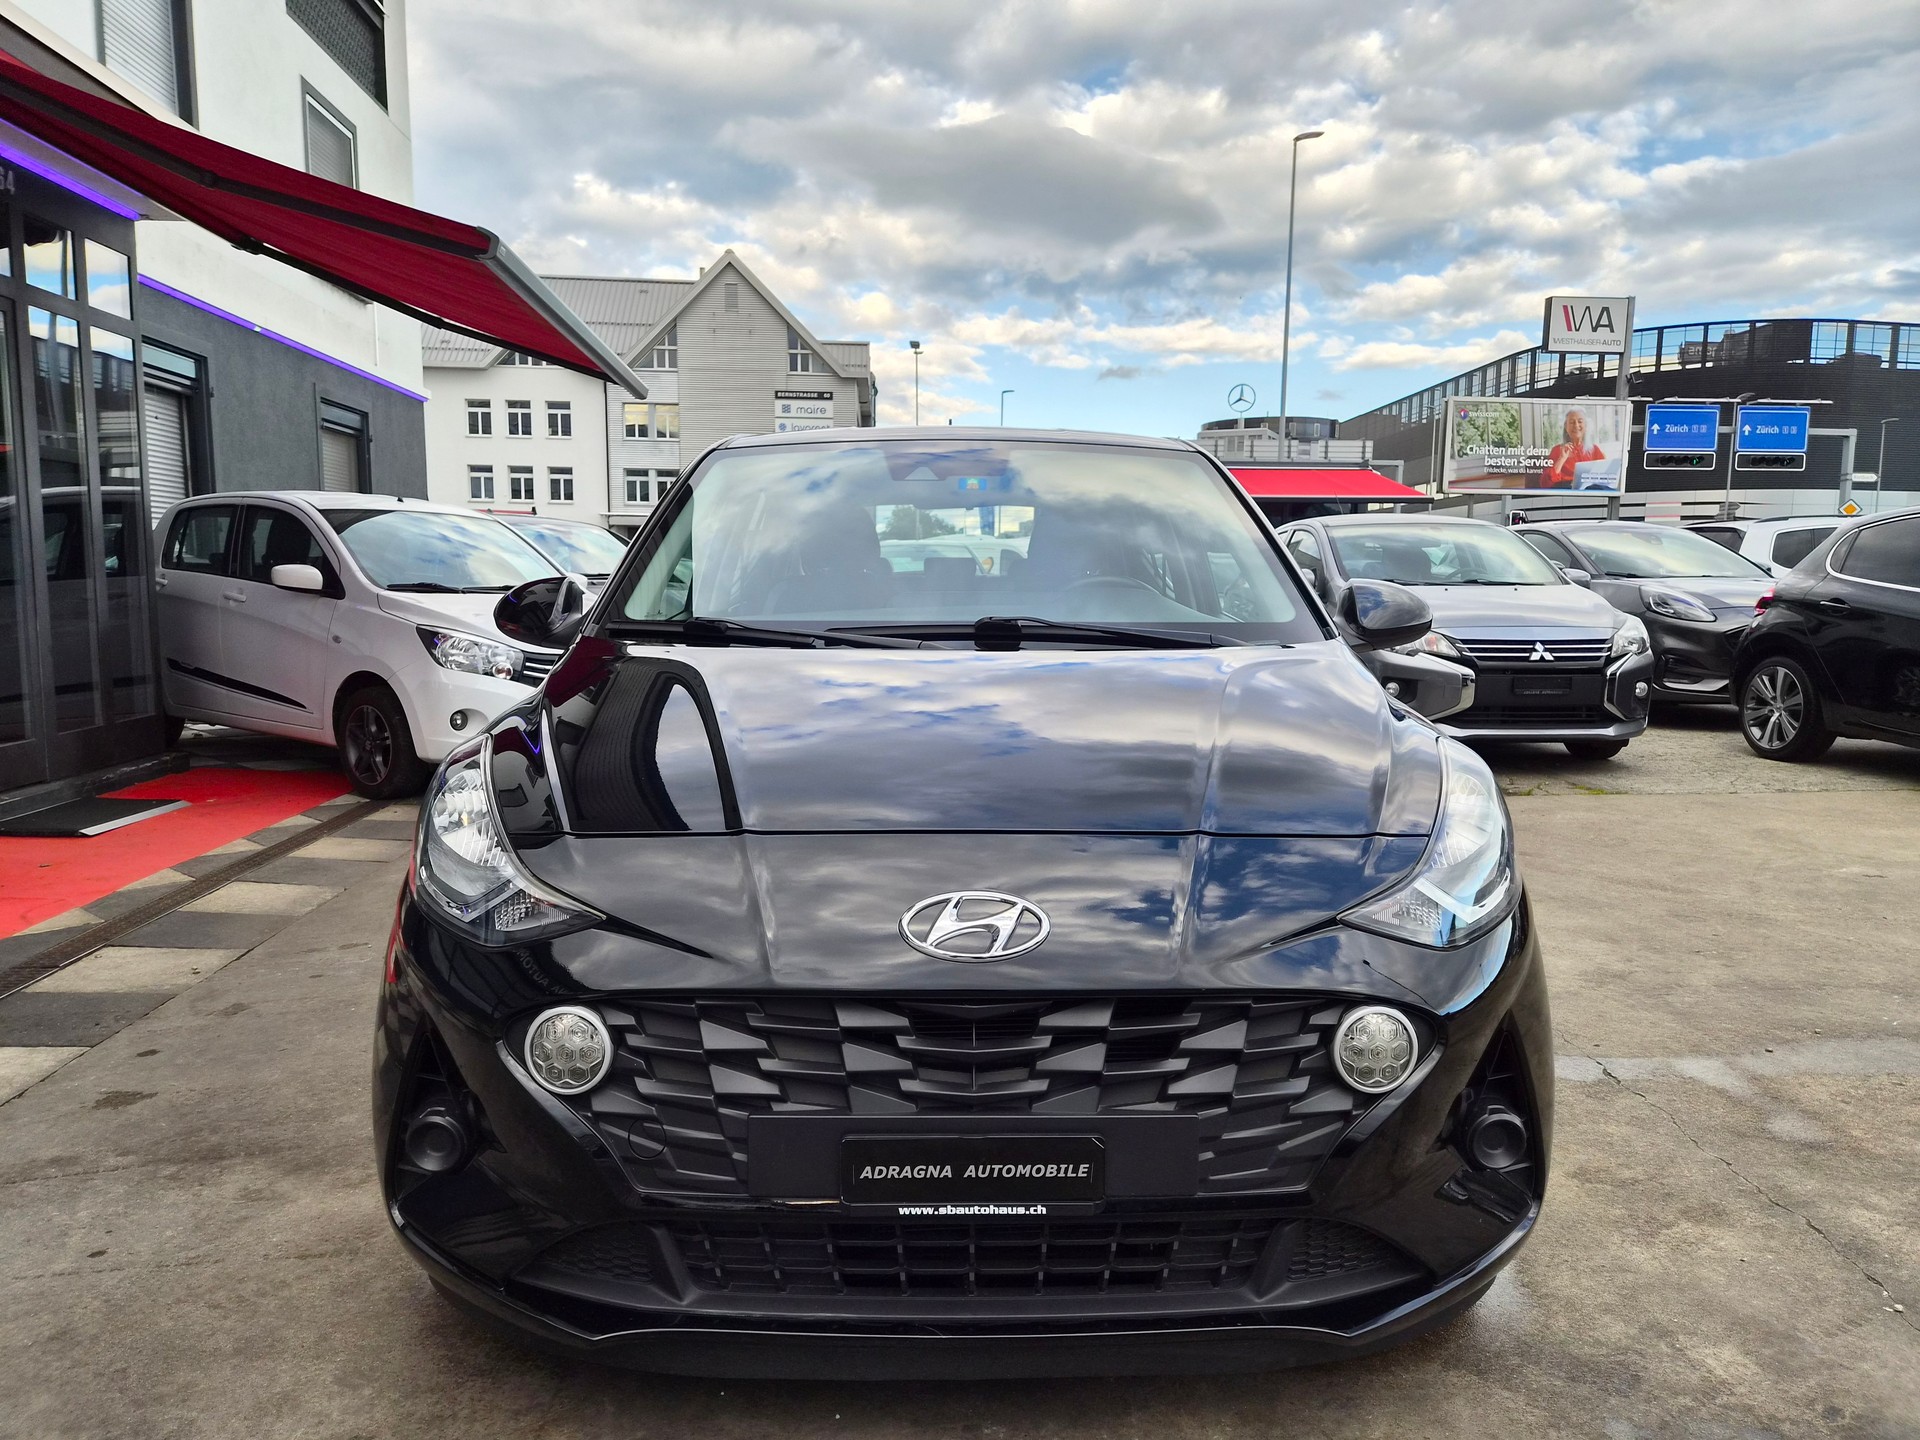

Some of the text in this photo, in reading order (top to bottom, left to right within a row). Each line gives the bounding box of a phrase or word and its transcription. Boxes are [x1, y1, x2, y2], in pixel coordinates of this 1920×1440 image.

[796, 404, 827, 415] maire
[1468, 409, 1499, 417] swisscom
[1665, 424, 1689, 433] Zürich
[1755, 425, 1780, 434] Zürich
[1466, 445, 1549, 456] Chatten mit dem
[1484, 456, 1554, 468] besten Service
[859, 1163, 1089, 1180] ADRAGNA AUTOMOBILE
[898, 1205, 1047, 1215] www.sbautohaus.ch
